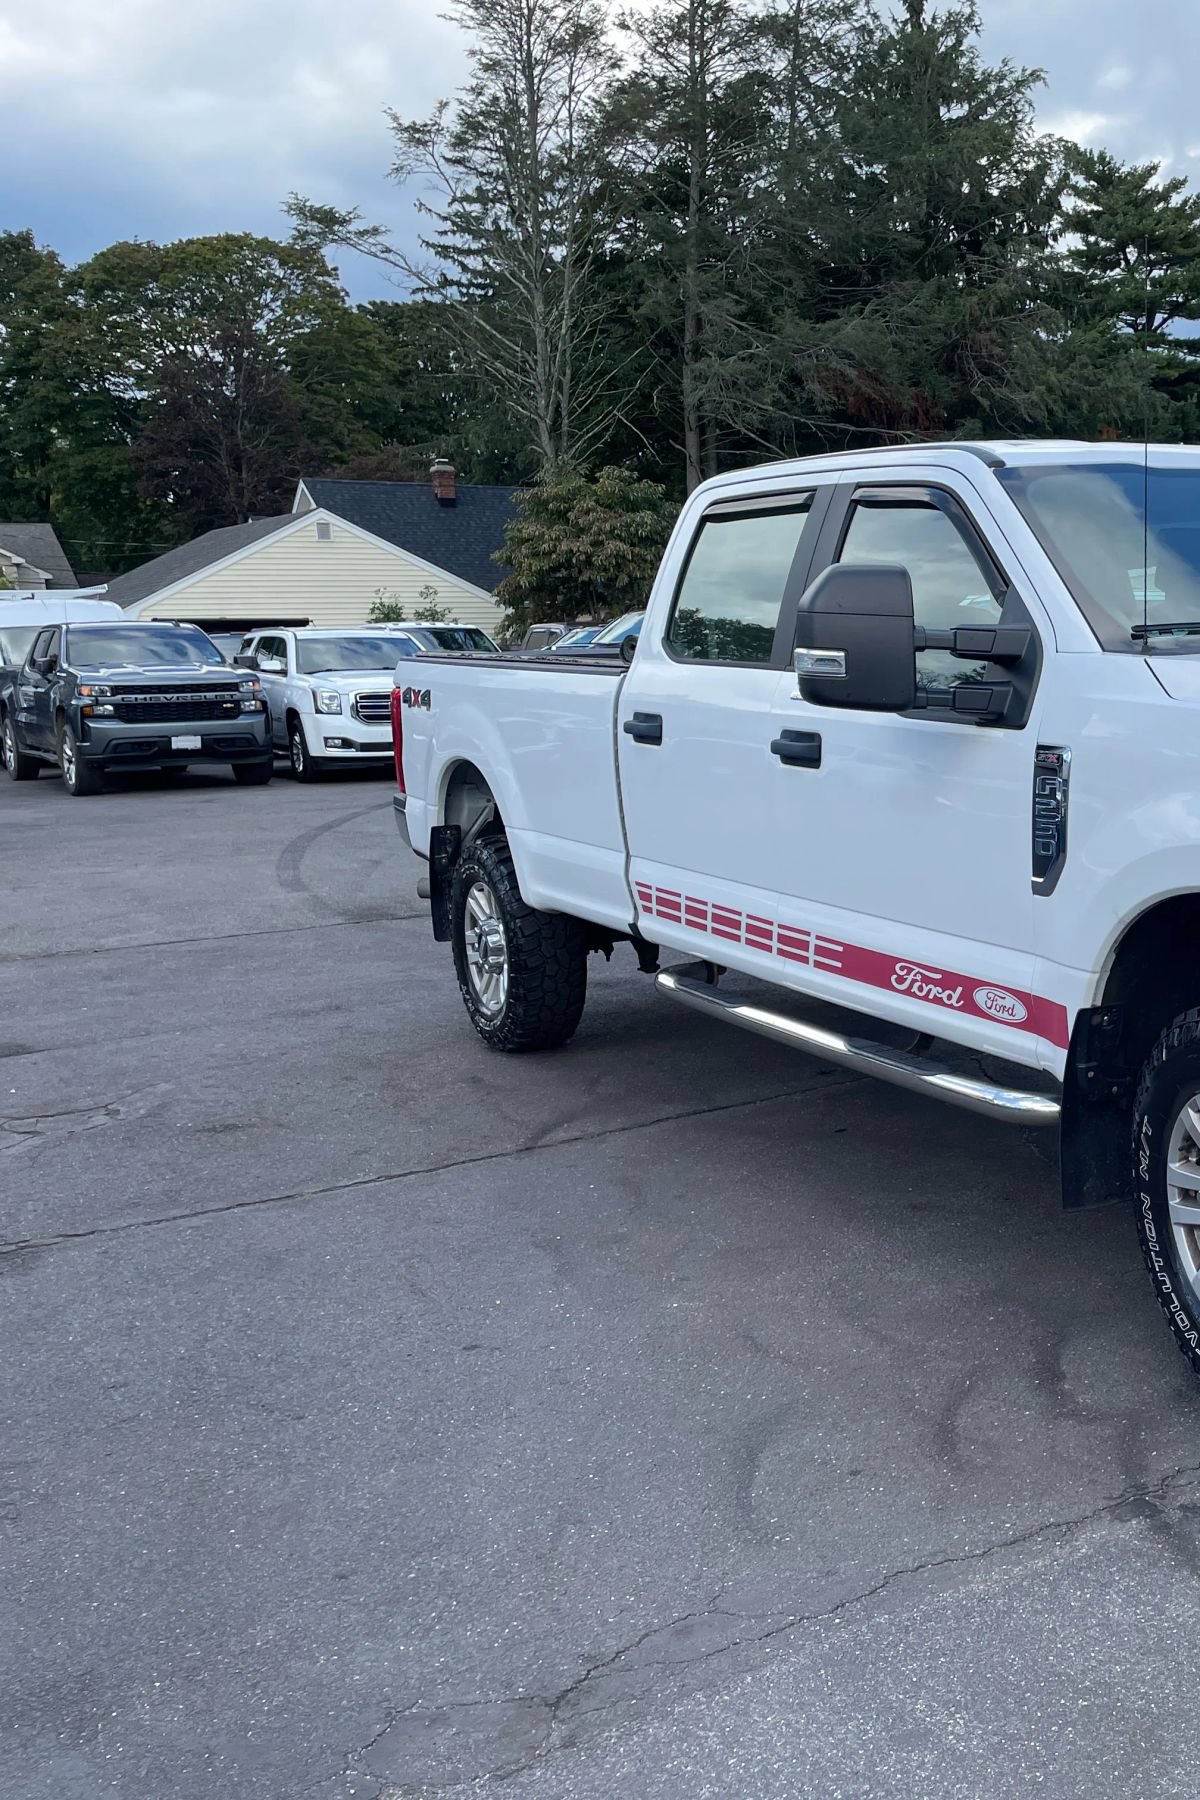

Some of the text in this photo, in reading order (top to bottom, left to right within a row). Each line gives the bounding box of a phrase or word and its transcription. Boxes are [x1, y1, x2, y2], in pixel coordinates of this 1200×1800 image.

[121, 694, 237, 703] CHEVROLET
[890, 962, 964, 1007] Ford
[984, 991, 1017, 1018] Ford
